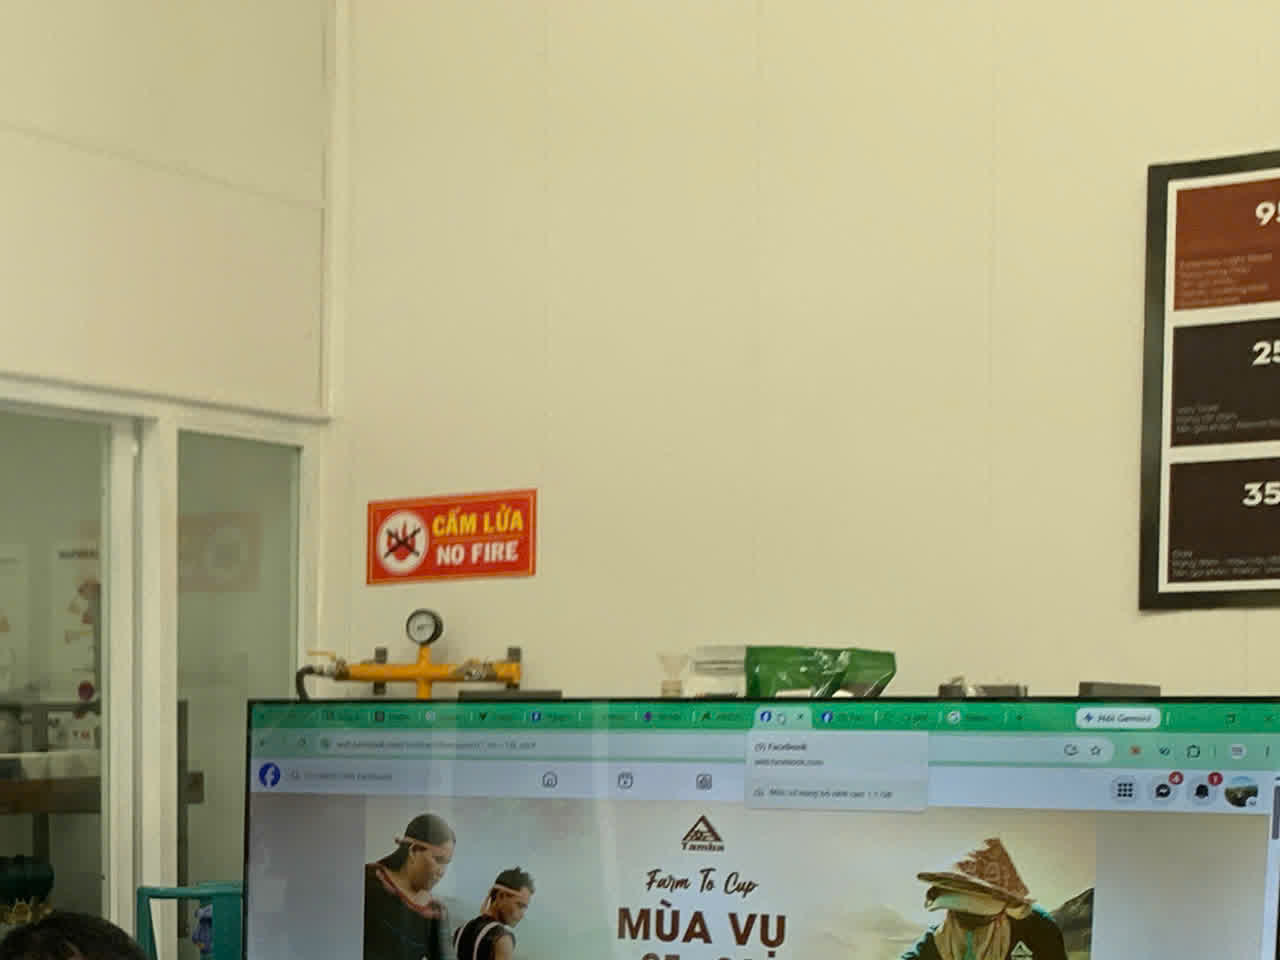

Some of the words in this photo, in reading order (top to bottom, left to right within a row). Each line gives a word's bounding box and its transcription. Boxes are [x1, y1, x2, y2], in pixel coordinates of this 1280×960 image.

[1255, 201, 1280, 227] 9
[432, 505, 477, 537] CẤM
[484, 502, 523, 533] LỬA
[436, 544, 465, 566] NO
[471, 540, 518, 564] FIRE
[646, 867, 691, 893] Farm
[699, 867, 716, 893] To
[724, 871, 758, 899] Cup
[617, 898, 713, 944] MÙA
[728, 912, 786, 958] VỤ
